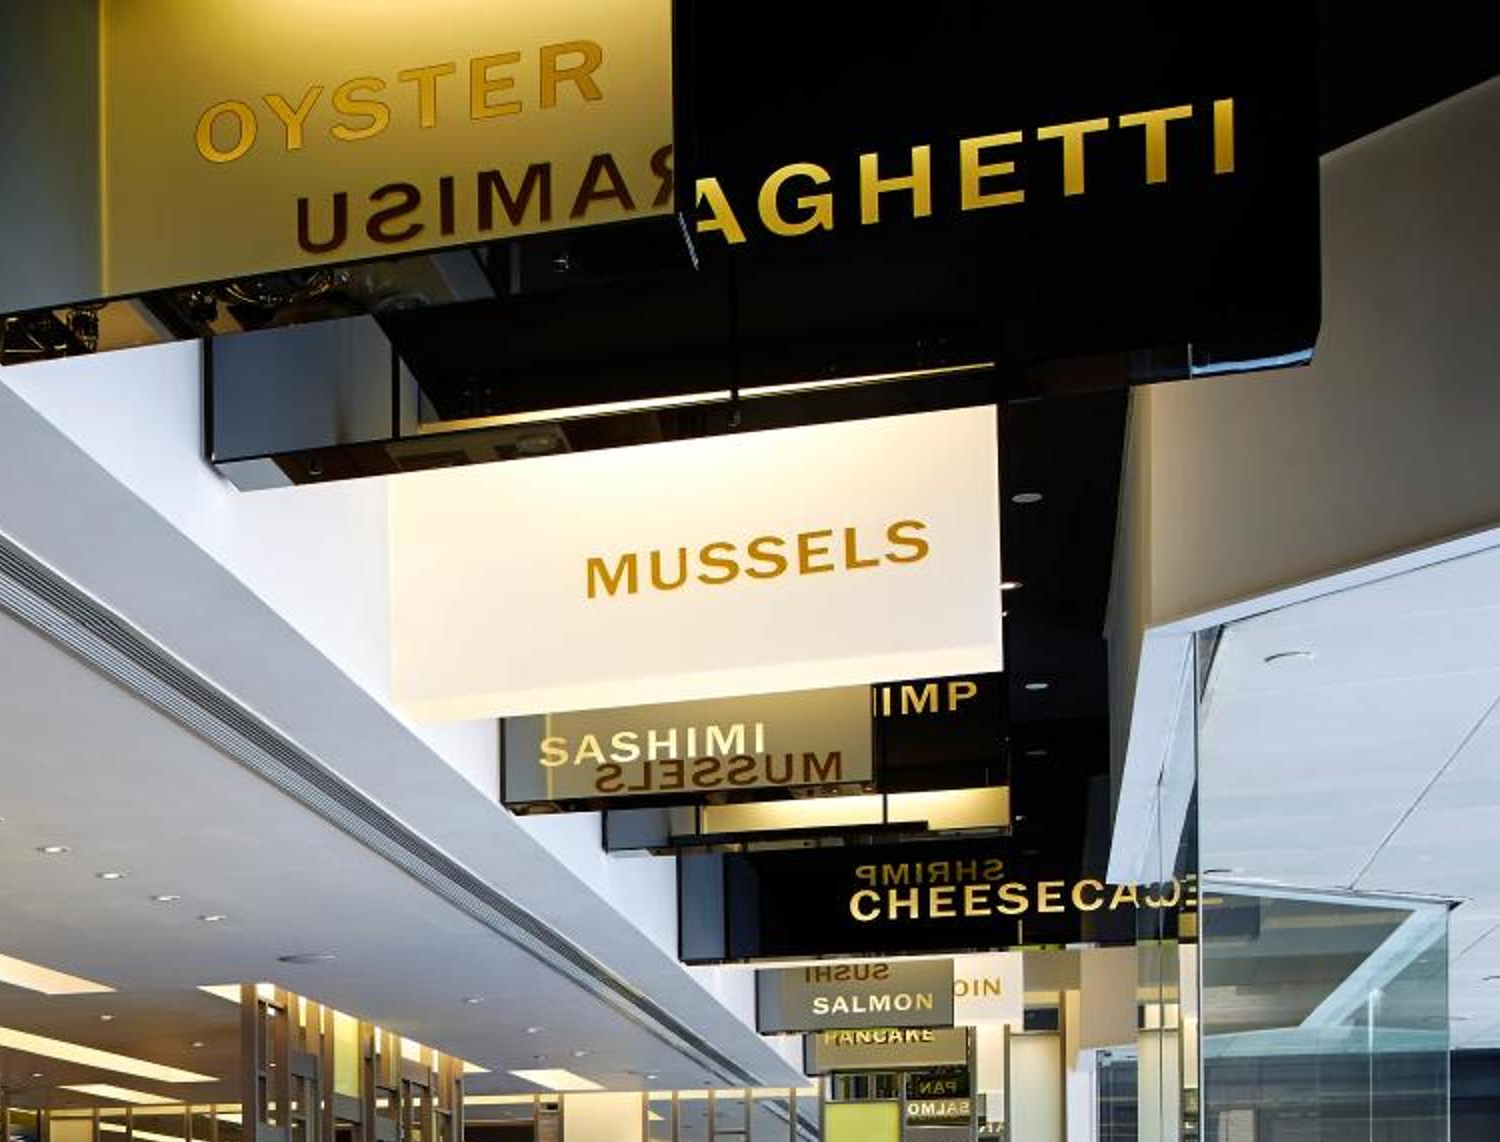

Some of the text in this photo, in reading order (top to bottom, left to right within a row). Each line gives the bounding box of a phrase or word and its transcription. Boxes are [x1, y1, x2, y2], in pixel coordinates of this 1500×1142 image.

[195, 40, 603, 163] OYSTER
[586, 519, 930, 599] MUSSELS
[539, 722, 765, 767] SASHIMI
[812, 993, 933, 1015] SALMON
